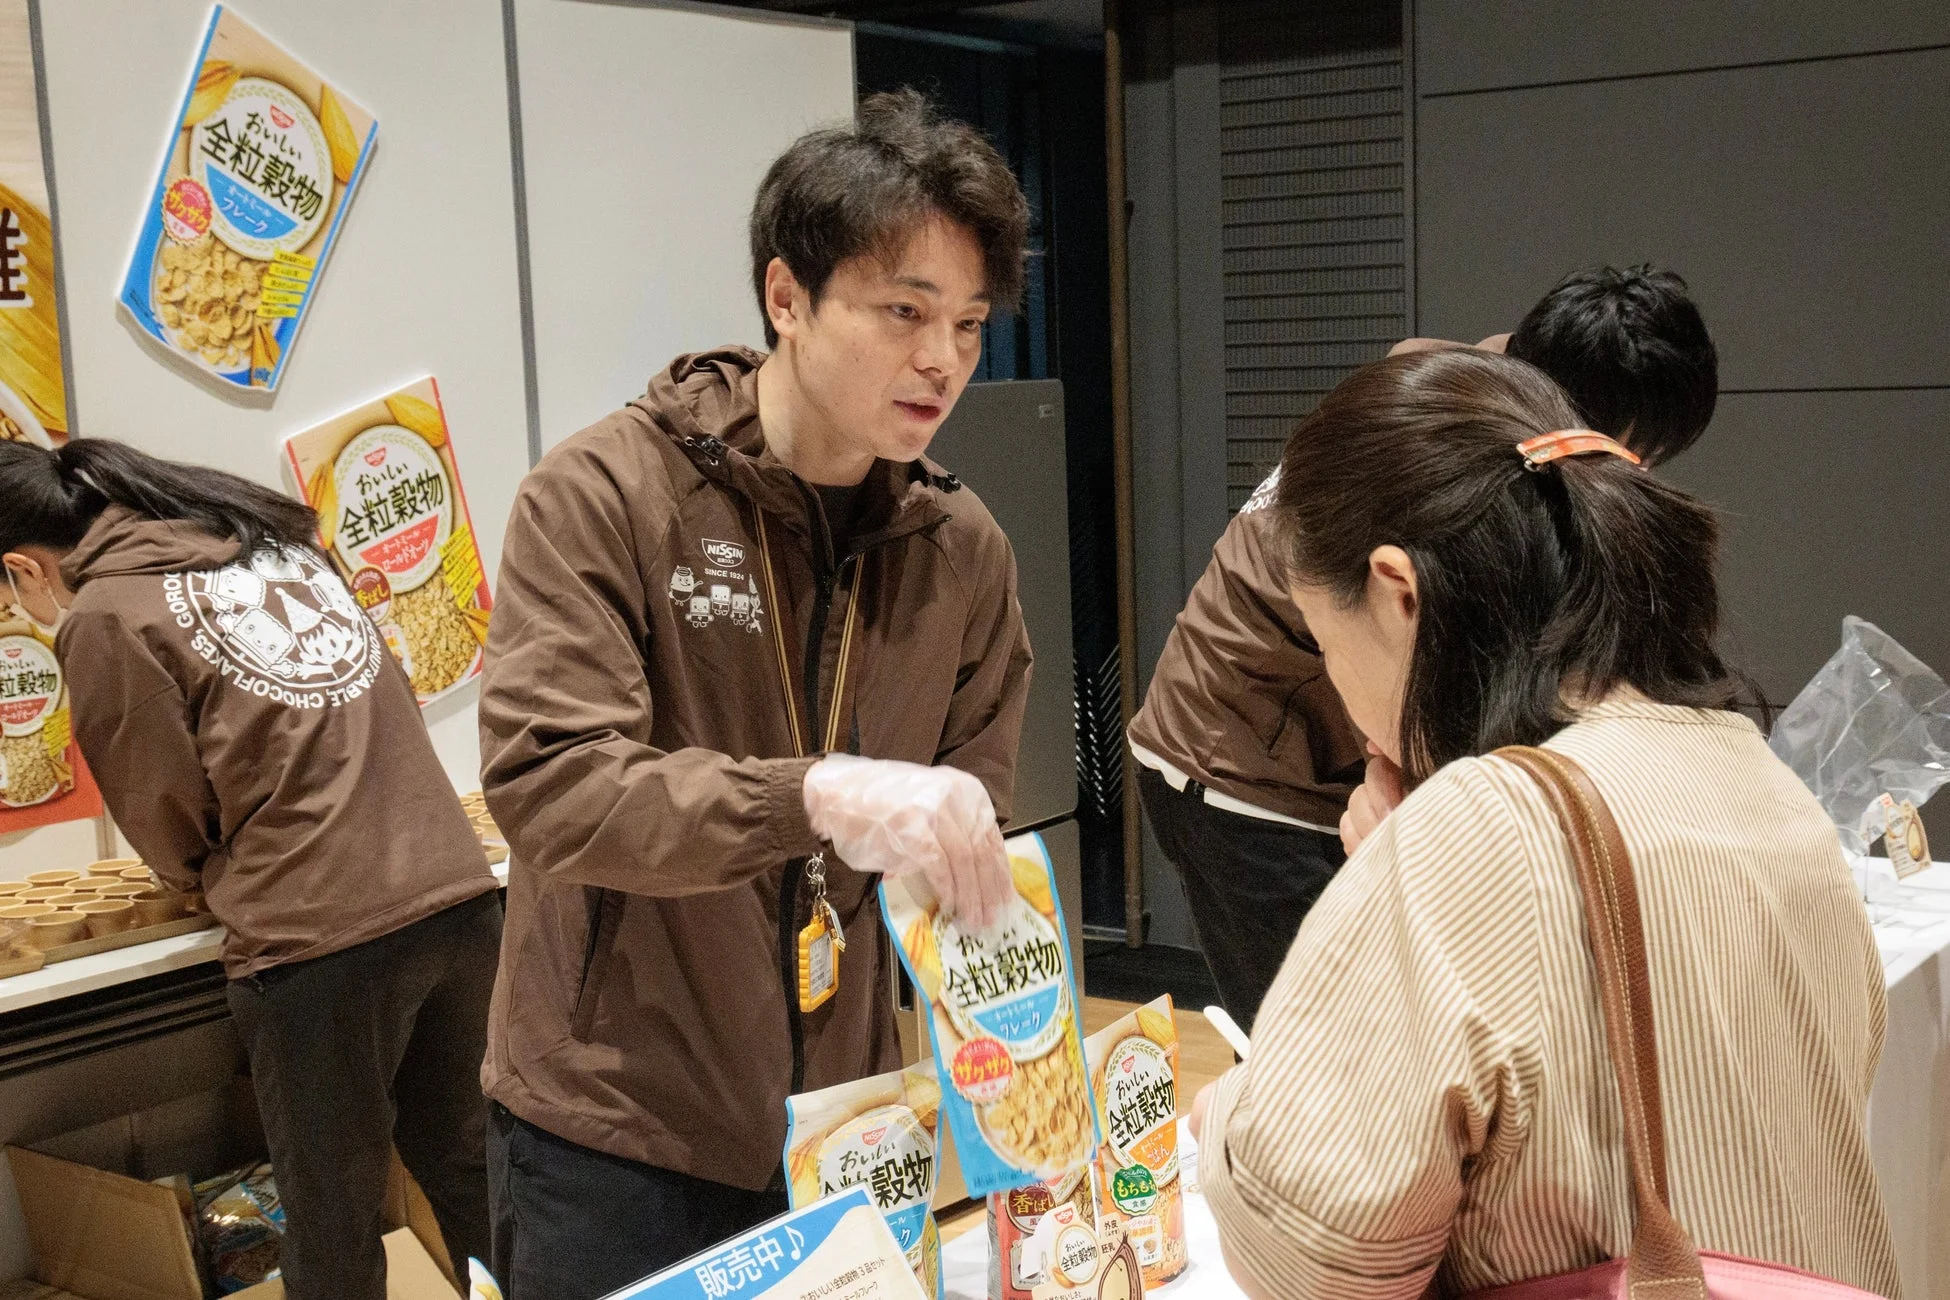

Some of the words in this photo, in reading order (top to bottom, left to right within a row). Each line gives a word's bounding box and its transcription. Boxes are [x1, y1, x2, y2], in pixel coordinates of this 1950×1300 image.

[246, 112, 302, 160] おいしい
[200, 118, 323, 221] 全粒穀物
[220, 197, 268, 233] フレーク
[355, 462, 409, 496] おいしい
[339, 468, 444, 550] 全粒穀物
[707, 543, 743, 559] NISSIN
[704, 567, 728, 577] SINCE
[729, 571, 745, 581] 1924
[945, 936, 1063, 1009] 全粒穀物
[1115, 1070, 1150, 1101] おいしい
[1108, 1078, 1175, 1150] 全粒穀物
[839, 1142, 896, 1173] おいしい
[1060, 1245, 1098, 1272] 全粒穀物
[1064, 1239, 1086, 1252] おいしい
